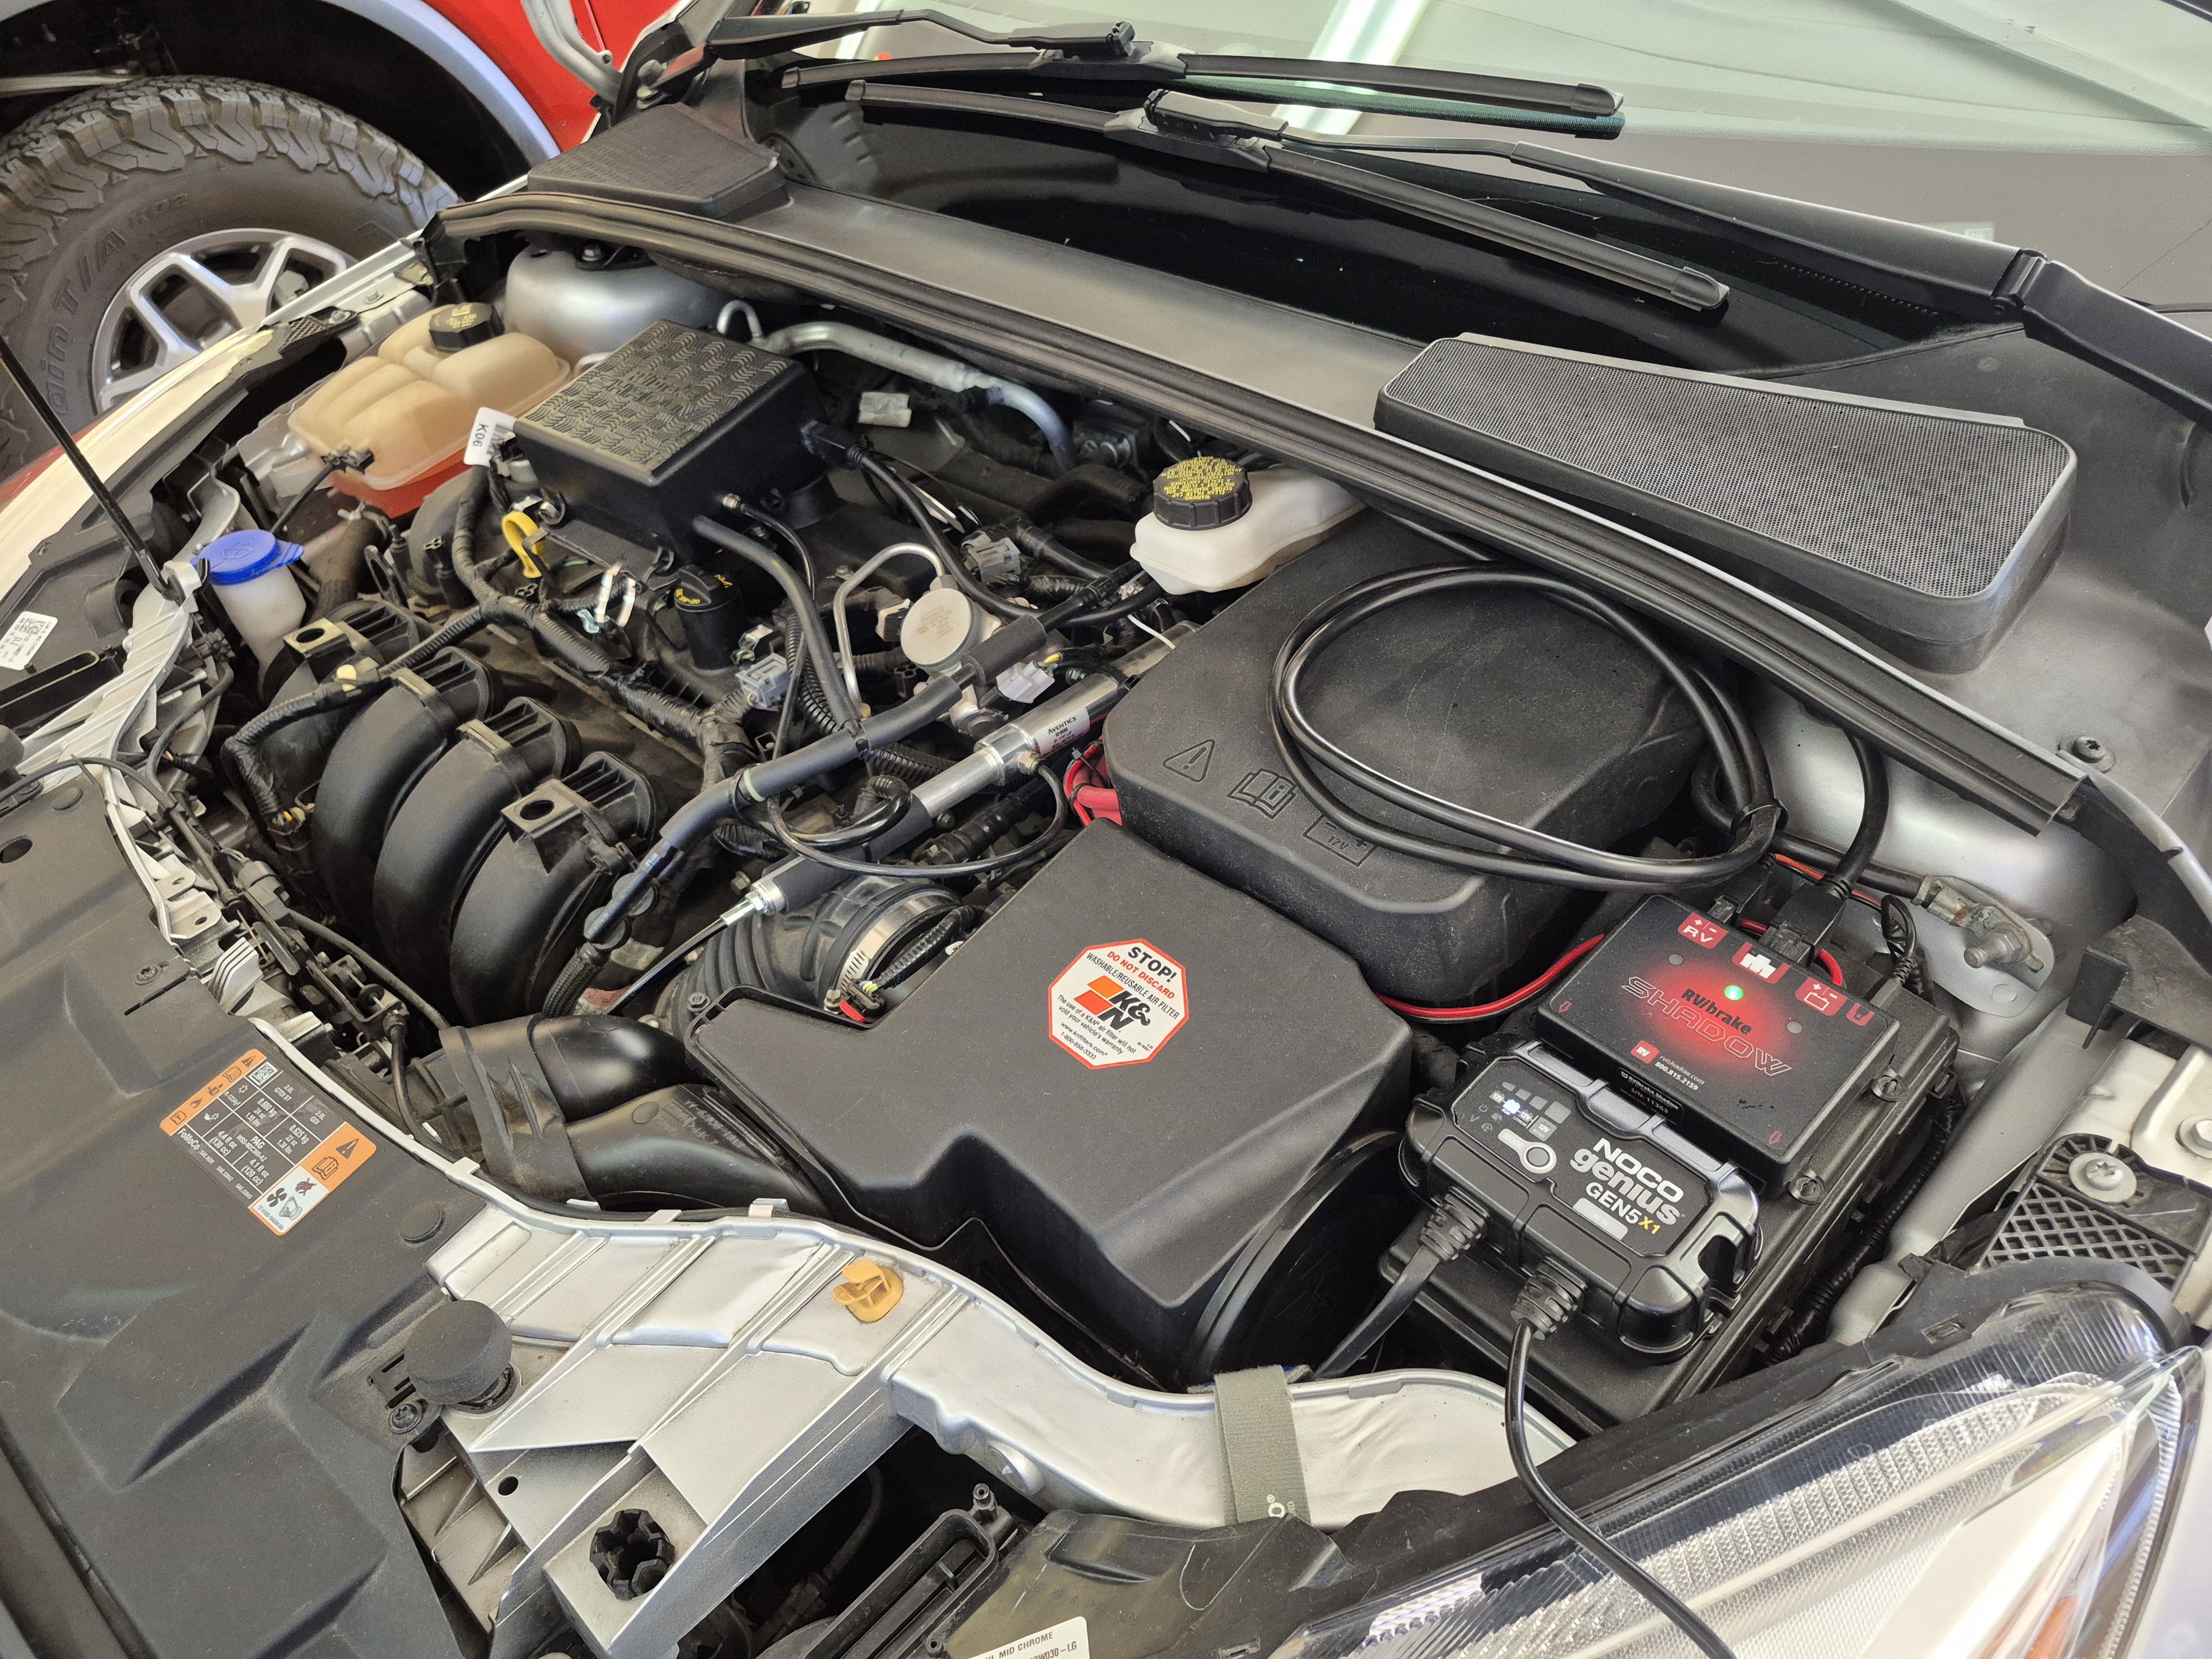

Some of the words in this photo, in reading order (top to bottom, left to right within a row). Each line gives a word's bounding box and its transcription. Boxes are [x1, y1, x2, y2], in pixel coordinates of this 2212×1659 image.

[473, 424, 489, 447] K06
[1048, 715, 1077, 735] AVENTICS
[1328, 836, 1348, 849] 12V
[1683, 925, 1713, 942] RV
[1128, 947, 1177, 983] STOP!
[1107, 951, 1120, 961] DO
[1120, 959, 1139, 973] NOT
[1138, 971, 1175, 999] DISCARD
[1087, 952, 1149, 998] WASHABLE/REUSABLE
[1146, 994, 1160, 1004] AIR
[1158, 1001, 1180, 1019] FILTER
[1057, 994, 1067, 1004] The
[1065, 1001, 1076, 1011] use
[1097, 1024, 1107, 1032] air
[1104, 1029, 1119, 1041] filter
[1117, 1037, 1128, 1047] will
[1125, 1044, 1136, 1054] not
[1058, 1005, 1070, 1015] void
[1067, 1013, 1081, 1024] your
[1079, 1021, 1103, 1039] vehicle's
[1100, 1036, 1124, 1056] warranty
[1621, 976, 1792, 1076] SHADOW
[1060, 1031, 1097, 1060] 1-800-858-3333
[1636, 1046, 1651, 1057] RV
[1655, 1062, 1698, 1091] 800.815.2159
[1660, 1056, 1704, 1085] rvishadow.com
[274, 1087, 285, 1098] GTDI
[284, 1084, 294, 1094] 2.0L
[1631, 1088, 1645, 1099] S/N:
[1655, 1092, 1679, 1110] Shadow
[269, 1107, 277, 1118] kg
[309, 1115, 321, 1125] GDI
[314, 1110, 327, 1120] 2.0L
[1521, 1112, 1532, 1120] 12V
[289, 1124, 305, 1138] 0.625
[301, 1134, 310, 1145] kg
[1538, 1124, 1550, 1133] 12V
[178, 1128, 200, 1151] FoMoCo
[209, 1136, 223, 1149] (130
[221, 1146, 231, 1157] cc)
[218, 1131, 228, 1140] 4.4
[225, 1136, 233, 1145] fl
[251, 1136, 265, 1149] PAG
[1503, 1132, 1525, 1150] MODE
[199, 1150, 208, 1159] SAE
[284, 1146, 293, 1155] lbs
[216, 1166, 226, 1175] SAE
[241, 1165, 255, 1178] (120
[252, 1175, 264, 1185] cc)
[250, 1159, 260, 1168] 4.1
[257, 1165, 265, 1173] fl
[1593, 1138, 1684, 1203] NOCO
[235, 1183, 244, 1192] SAE
[1570, 1149, 1680, 1225] genius
[999, 1647, 1015, 1658] MID
[1018, 1631, 1053, 1651] CHROME
